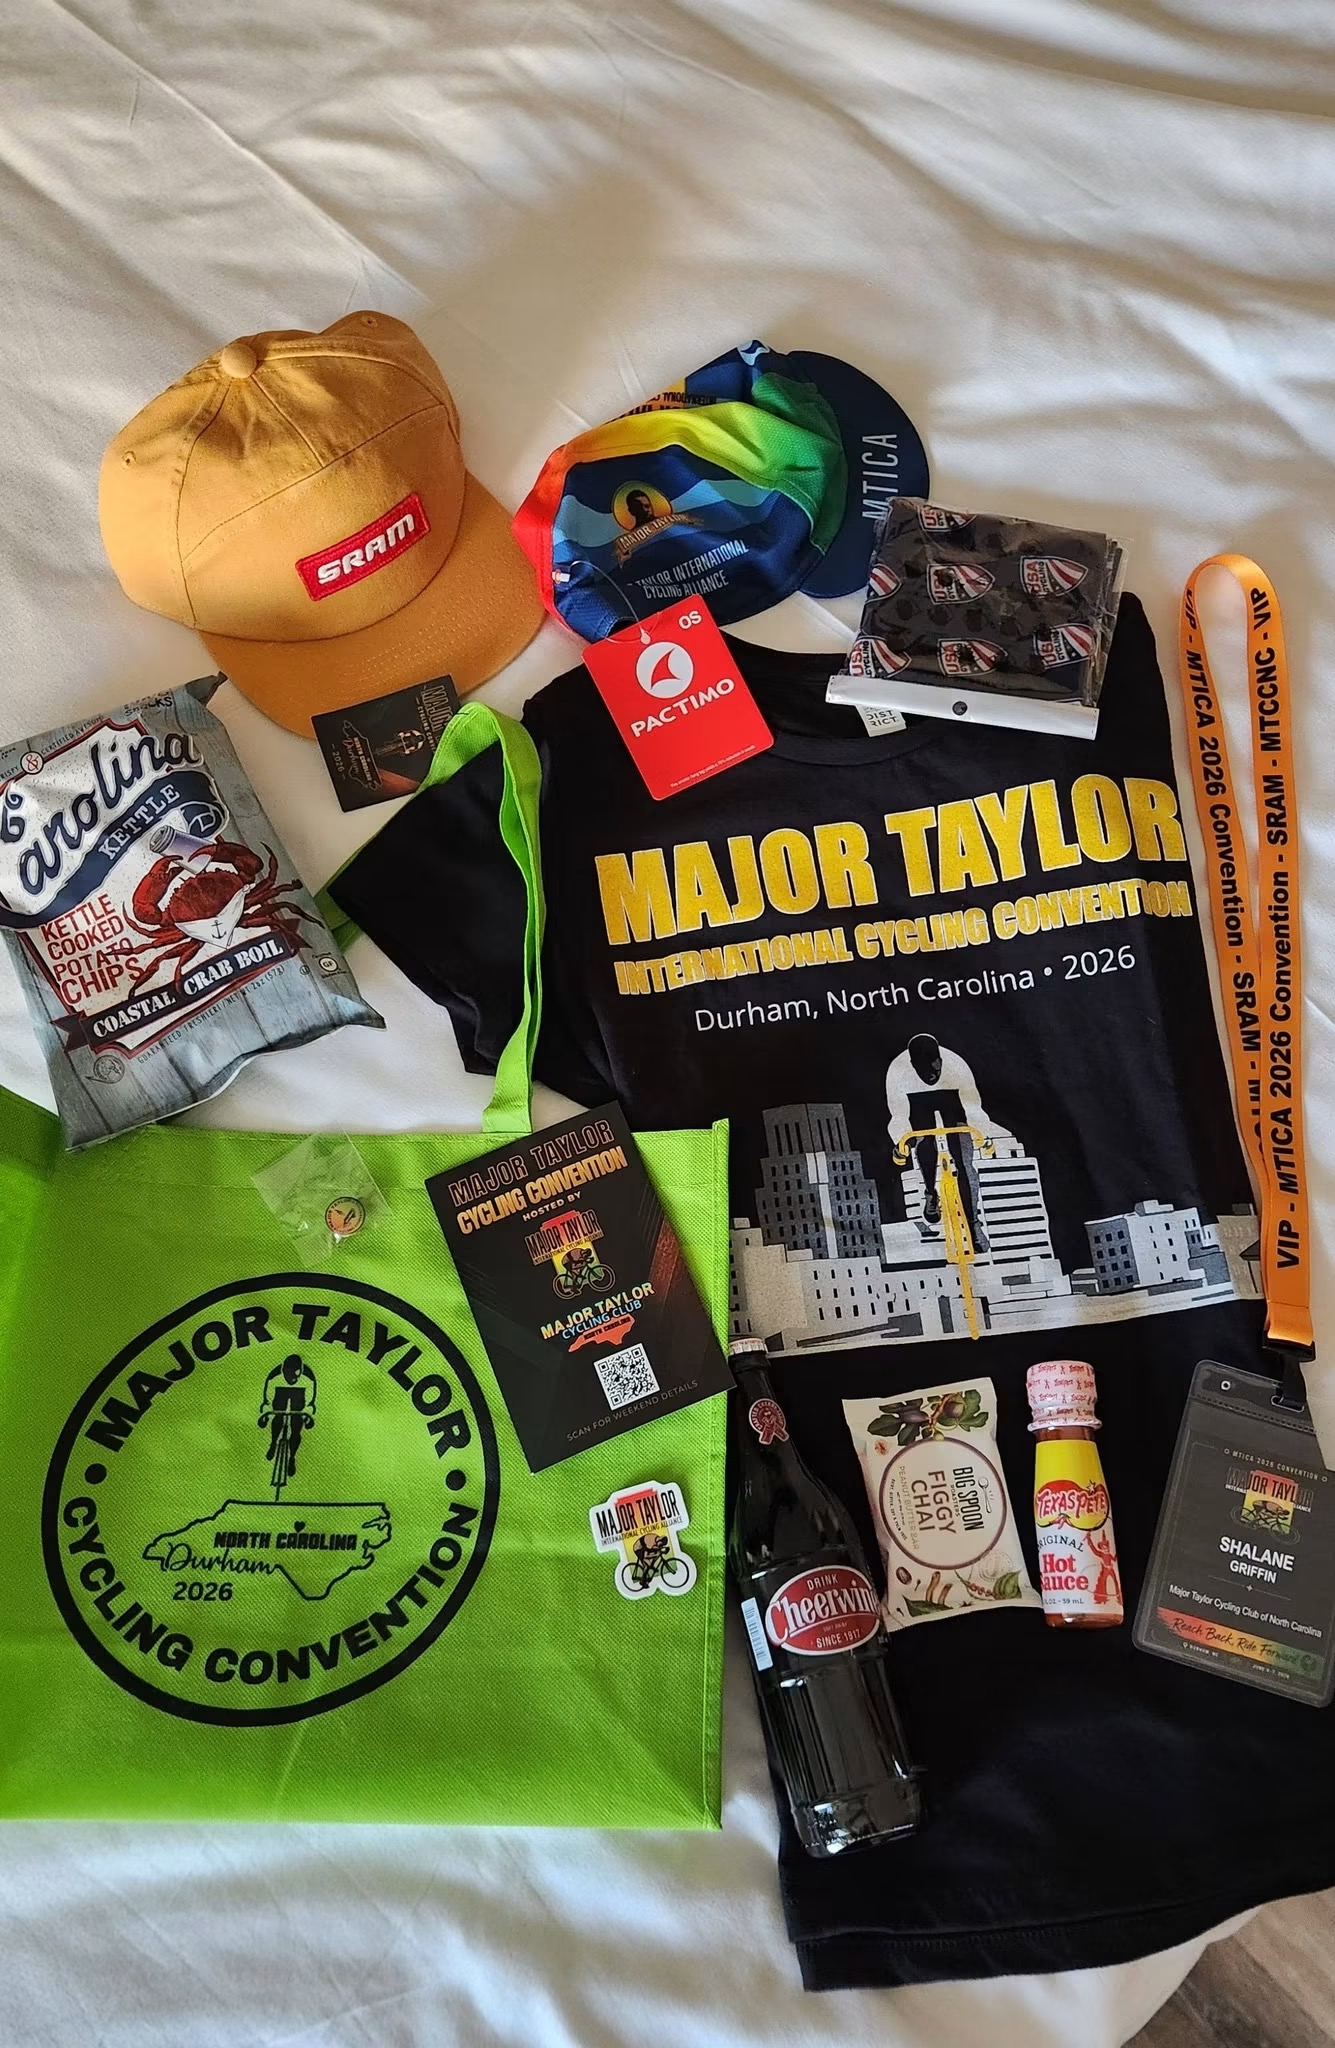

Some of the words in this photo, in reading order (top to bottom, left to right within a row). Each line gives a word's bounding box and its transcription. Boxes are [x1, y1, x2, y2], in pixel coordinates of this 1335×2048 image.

[861, 433, 899, 520] MTICA
[619, 525, 652, 549] MAJOR
[923, 505, 937, 527] US
[317, 513, 416, 585] SRAM
[635, 570, 673, 587] TAYLOR
[673, 539, 749, 582] INTERNATIONAL
[643, 584, 683, 600] CYCLING
[683, 569, 729, 596] ALLIANCE
[678, 610, 702, 630] OS
[1184, 587, 1198, 631] VIP
[1249, 586, 1269, 631] VIP
[851, 640, 865, 677] USA
[864, 640, 874, 676] CYCLING
[1041, 640, 1058, 664] US
[630, 677, 735, 737] PACTIMO
[1186, 648, 1215, 729] MTICA
[1254, 646, 1282, 752] MTCCNC
[0, 764, 19, 781] RISPY
[40, 732, 75, 755] CERTIFIED
[332, 751, 345, 772] 2026
[1199, 736, 1227, 796] 2026
[1, 733, 199, 896] Carolina
[99, 783, 180, 860] KETTLE
[1267, 774, 1288, 846] SRAM
[595, 820, 878, 946] MAJOR
[885, 773, 1188, 897] TAYLOR
[1208, 803, 1245, 948] Convention
[41, 894, 116, 943] KETTLE
[47, 915, 124, 961] COOKED
[614, 926, 854, 995] INTERNATIONAL
[856, 903, 990, 960] CYCLING
[993, 878, 1193, 940] CONVENTION
[52, 938, 134, 982] POTATO
[1267, 870, 1292, 1023] Convention
[61, 956, 145, 1005] CHIPS
[92, 990, 177, 1038] COASTAL
[183, 962, 233, 996] CRAB
[236, 938, 284, 970] BOIL
[695, 996, 818, 1032] Durham,
[826, 982, 910, 1017] North
[917, 965, 1035, 1003] Carolina
[1062, 944, 1137, 981] 2026
[1233, 970, 1261, 1052] SRAM
[137, 1028, 183, 1065] GUARANTEED
[1269, 1030, 1293, 1099] 2026
[448, 1154, 529, 1208] MAJOR
[530, 1119, 615, 1171] TAYLOR
[1270, 1106, 1300, 1195] MTICA
[456, 1188, 526, 1235] CYCLING
[525, 1145, 629, 1204] CONVENTION
[522, 1199, 564, 1222] HOSTED
[567, 1190, 582, 1203] BY
[525, 1226, 562, 1260] MAJOR
[560, 1209, 602, 1245] TAYLOR
[535, 1246, 566, 1264] INTERNATIONAL
[565, 1239, 584, 1252] CYCLING
[1276, 1219, 1301, 1269] VIP
[540, 1306, 594, 1340] MAJOR
[594, 1281, 656, 1314] TAYLOR
[561, 1311, 611, 1339] CYCLING
[612, 1299, 642, 1319] CLUB
[583, 1326, 605, 1341] NORTH
[84, 1304, 273, 1453] MAJOR
[291, 1303, 473, 1460] TAYLOR
[566, 1422, 590, 1442] SCAN
[592, 1414, 612, 1432] FOR
[612, 1395, 660, 1423] WEEKEND
[660, 1378, 699, 1405] DETAILS
[898, 1466, 910, 1495] PEANUT
[953, 1466, 976, 1489] BIG
[1226, 1465, 1269, 1496] MAJOR
[1270, 1479, 1315, 1507] TAYLOR
[1232, 1450, 1255, 1463] MTICA
[1256, 1457, 1274, 1468] 2026
[1276, 1462, 1319, 1481] CONVENTION
[595, 1502, 639, 1539] MAJOR
[636, 1489, 680, 1527] TAYLOR
[904, 1499, 917, 1532] BUTTER
[911, 1479, 936, 1531] CHAI
[928, 1470, 957, 1534] FIGGY
[949, 1484, 961, 1518] ROASTERS
[957, 1489, 985, 1532] SPOON
[1037, 1489, 1076, 1519] TEXAS
[1075, 1490, 1107, 1519] PETE
[214, 1531, 270, 1550] NORTH
[275, 1531, 358, 1552] CAROLINA
[601, 1530, 639, 1546] INTERNATIONAL
[639, 1523, 661, 1537] CYCLING
[660, 1515, 683, 1529] ALLIANCE
[910, 1533, 920, 1550] BAR
[1037, 1534, 1084, 1553] RIGINAL
[163, 1541, 280, 1576] Durham
[1041, 1553, 1077, 1574] Hot
[1219, 1535, 1295, 1571] SHALANE
[1229, 1559, 1277, 1585] GRIFFIN
[63, 1496, 194, 1674] CYCLING
[204, 1502, 480, 1685] CONVENTION
[172, 1581, 234, 1602] 2026
[806, 1573, 839, 1591] DRINK
[1072, 1597, 1085, 1605] mL
[1169, 1583, 1190, 1599] Major
[1191, 1590, 1213, 1606] Taylor
[1213, 1597, 1241, 1616] Cycling
[1241, 1606, 1259, 1619] Club
[1259, 1611, 1269, 1622] of
[1269, 1614, 1290, 1628] North
[1290, 1620, 1322, 1639] Carolina
[816, 1632, 843, 1649] SINCE
[844, 1628, 861, 1643] 1917
[1172, 1617, 1203, 1635] Reach
[1204, 1626, 1234, 1647] Back,
[1236, 1636, 1257, 1652] Ride
